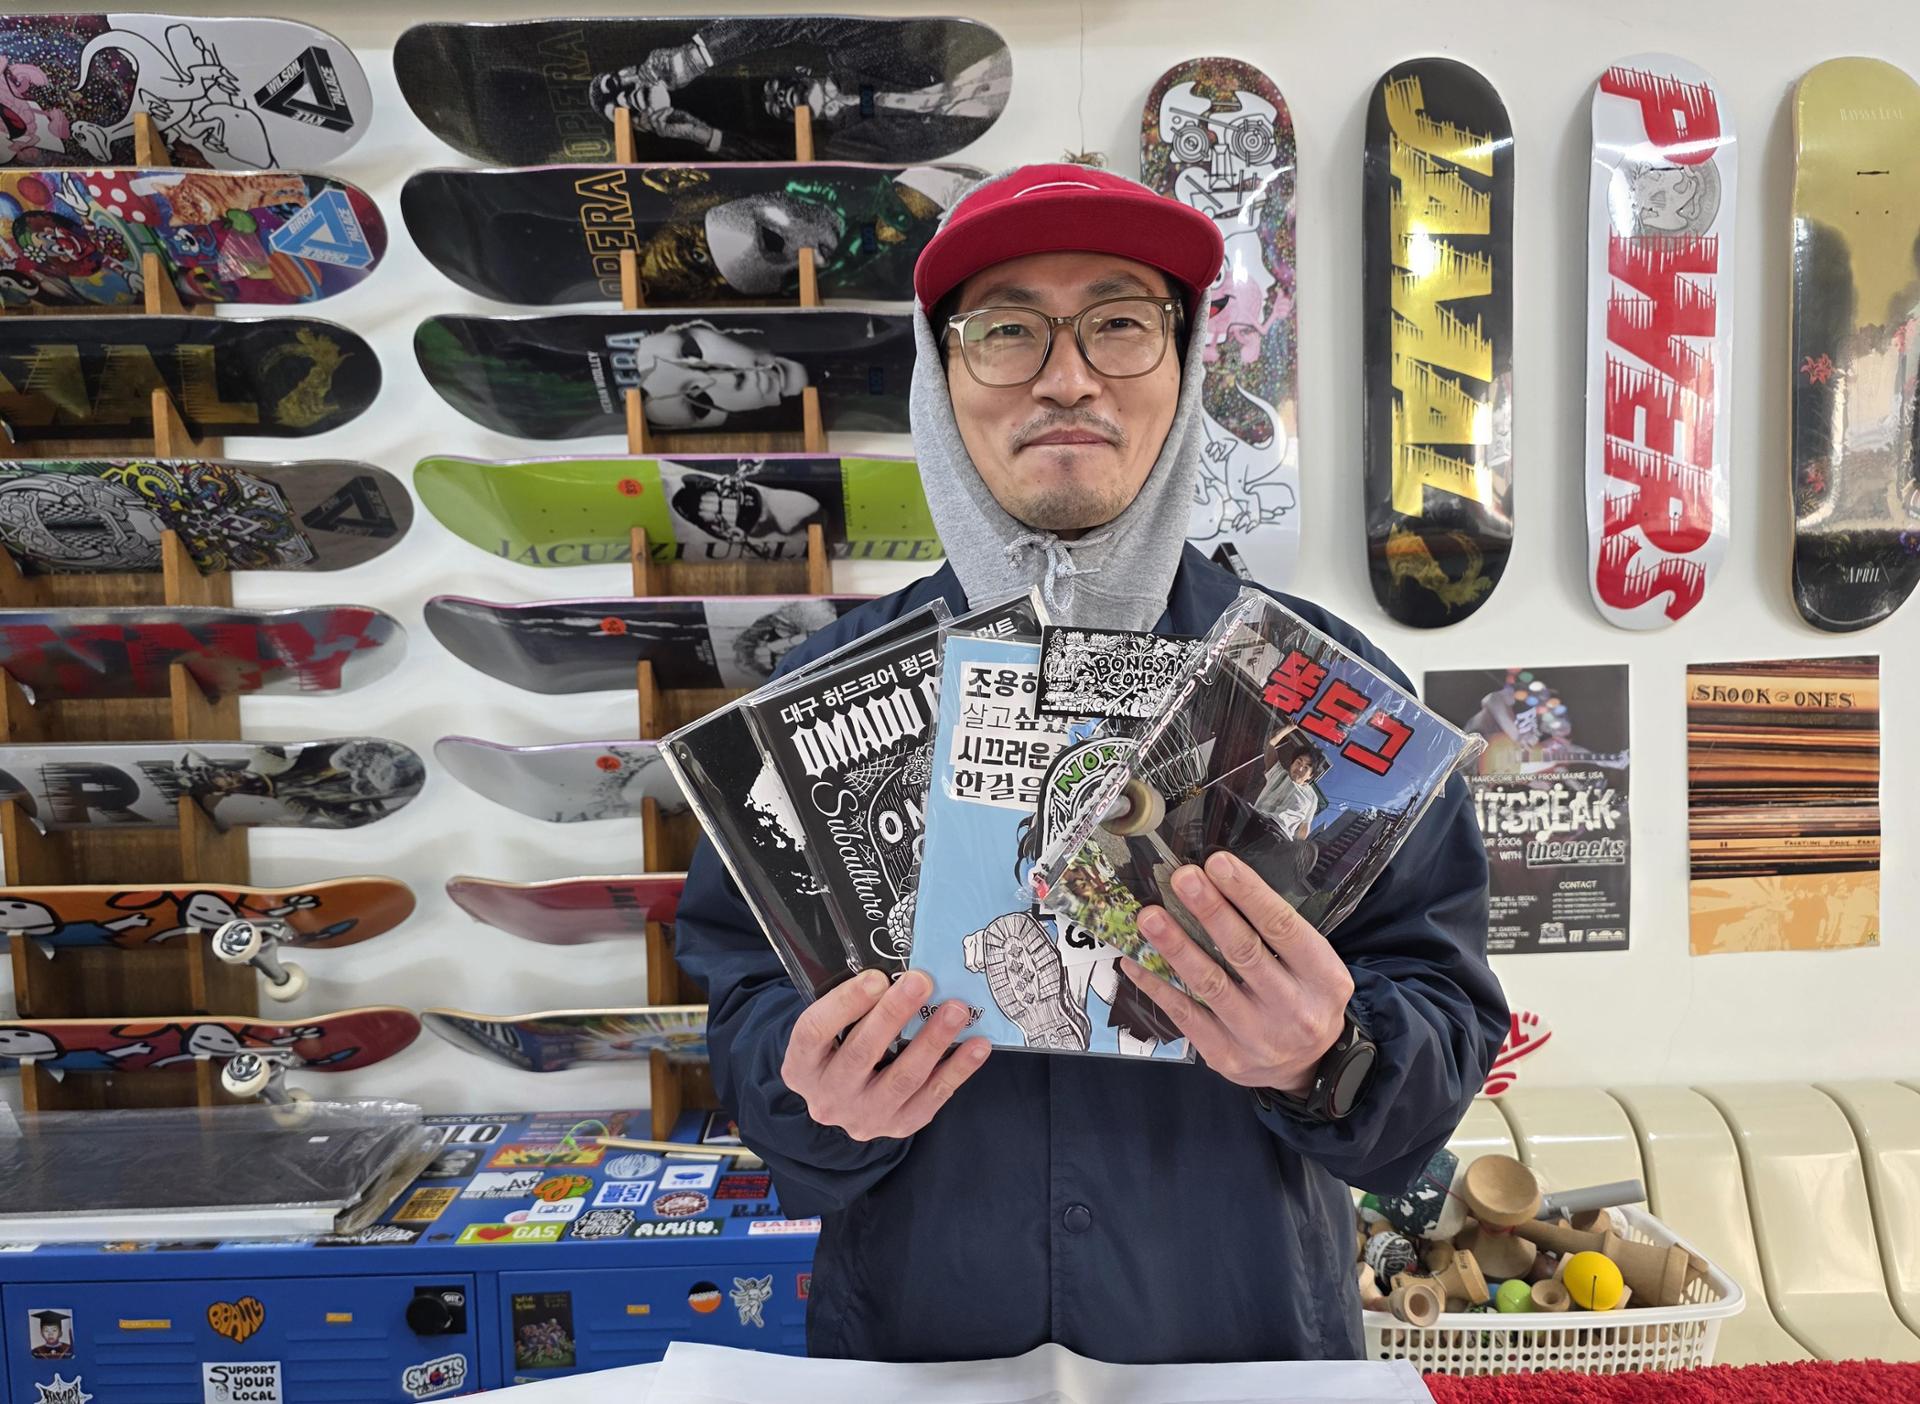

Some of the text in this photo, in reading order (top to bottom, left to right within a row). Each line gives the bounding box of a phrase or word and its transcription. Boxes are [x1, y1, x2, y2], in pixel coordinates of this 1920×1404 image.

[266, 59, 302, 95] WILSON
[287, 206, 316, 235] BIRCH
[1384, 74, 1492, 517] JAMAL
[780, 699, 820, 725] 대구
[822, 664, 899, 706] 하드코어
[899, 648, 940, 678] 펑크
[963, 703, 1011, 730] 살고
[811, 781, 884, 921] Subculture
[1497, 837, 1522, 847] 2006
[1558, 880, 1598, 890] CONTACT
[208, 1365, 276, 1384] SUPPORT
[233, 1377, 276, 1391] YOUR
[232, 1391, 277, 1401] LOCAL
